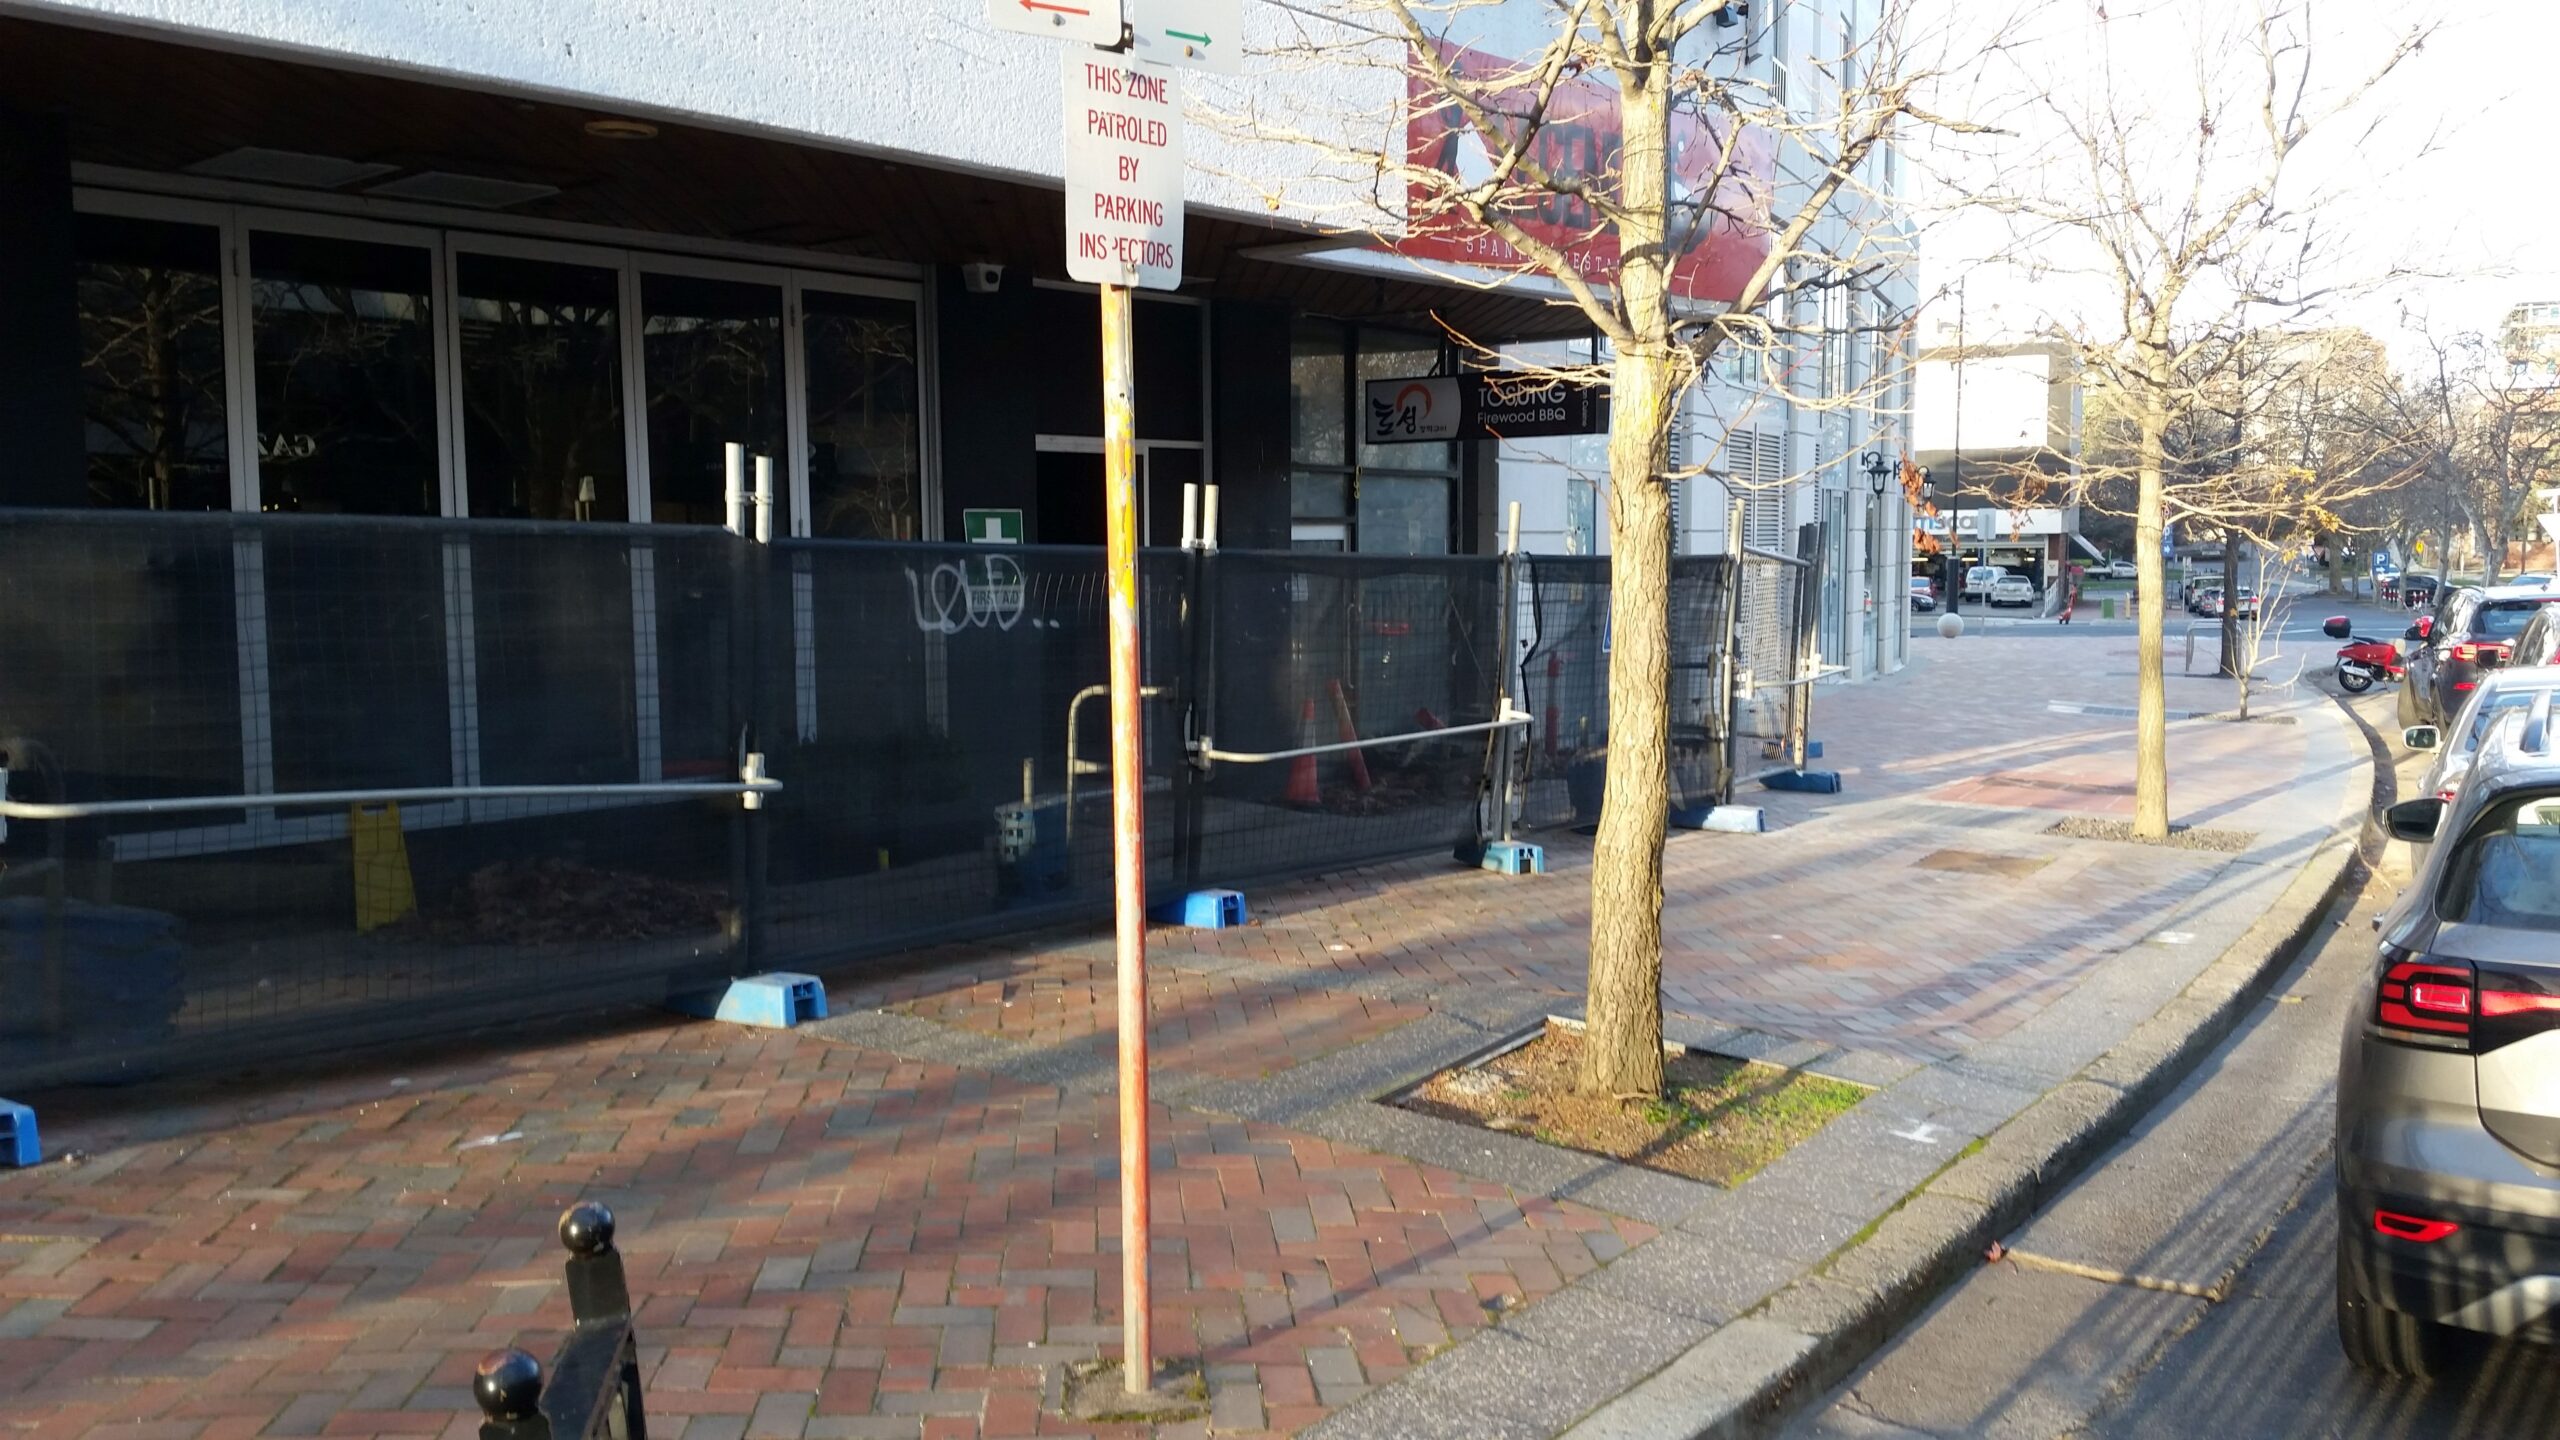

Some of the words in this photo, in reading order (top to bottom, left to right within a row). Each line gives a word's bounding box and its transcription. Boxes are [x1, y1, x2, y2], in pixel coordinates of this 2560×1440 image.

[1085, 63, 1122, 94] THIS
[1127, 71, 1168, 104] ZONE
[1088, 109, 1167, 147] PATROLED
[1119, 155, 1140, 183] BY
[1095, 193, 1163, 227] PARKING
[1478, 383, 1566, 408] TOSUNG
[1477, 409, 1535, 424] Firewood
[1539, 407, 1566, 421] BBQ
[2376, 554, 2386, 565] P
[1003, 590, 1019, 604] AID
